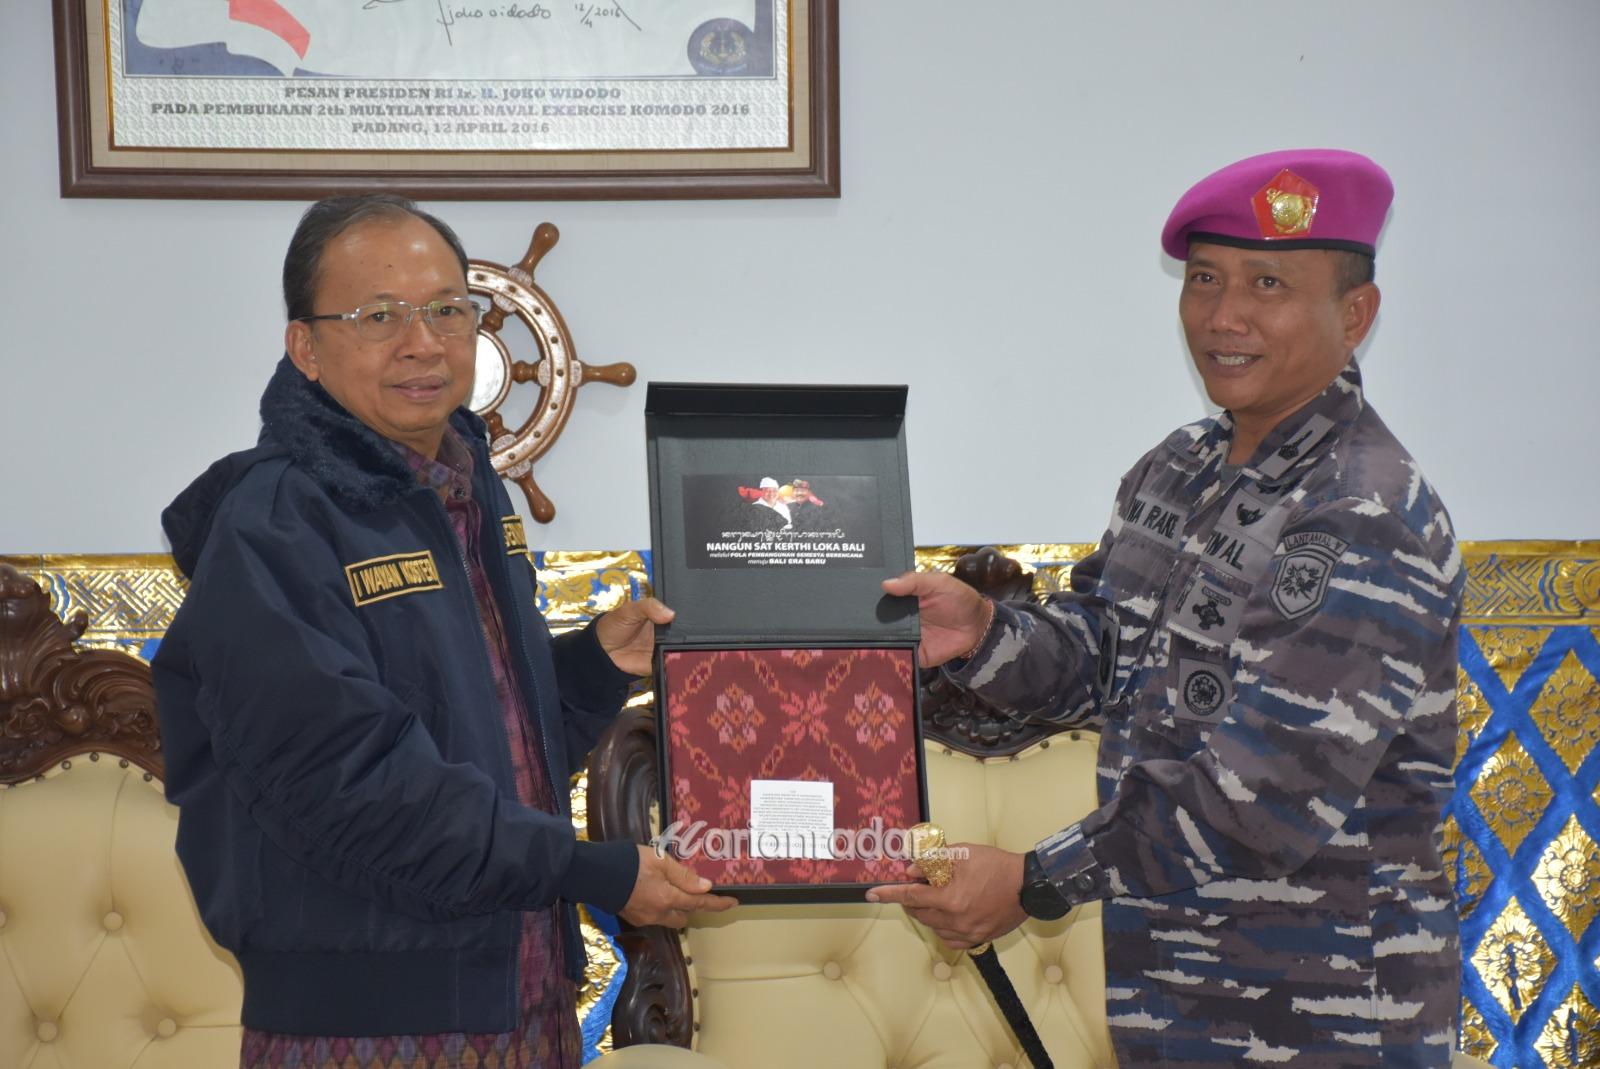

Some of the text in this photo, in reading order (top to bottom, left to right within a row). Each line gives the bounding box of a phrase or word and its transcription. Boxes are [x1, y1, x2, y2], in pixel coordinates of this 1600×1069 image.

[284, 87, 621, 101] PESAN PRESIDEN RI Ir. H. JOKO WIDODO
[151, 103, 750, 116] PADA PEMBUKAAN 2th MULTILATERAL NAVAL EXERCISE KOMODO 2016
[352, 122, 550, 135] PADANG, 12 APRIL 2016
[706, 542, 865, 552] NANGUN SAT KERTHI LOKA BALI
